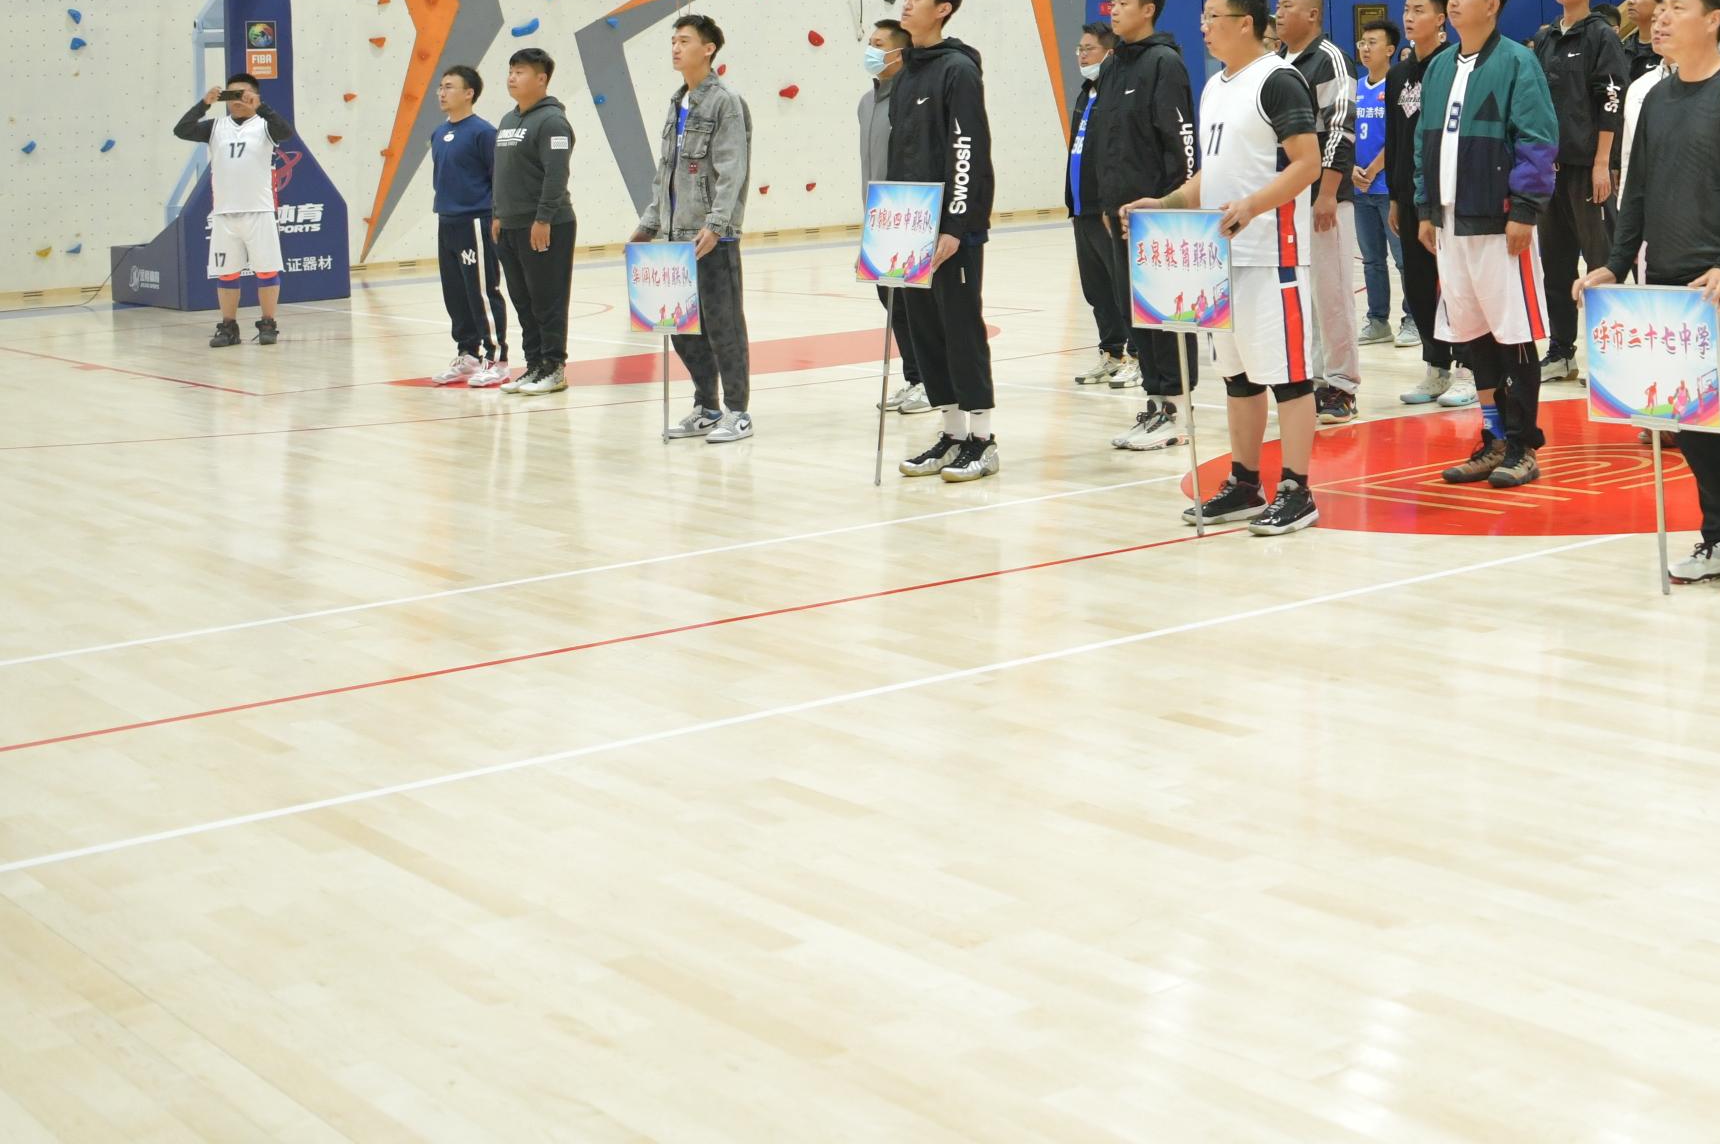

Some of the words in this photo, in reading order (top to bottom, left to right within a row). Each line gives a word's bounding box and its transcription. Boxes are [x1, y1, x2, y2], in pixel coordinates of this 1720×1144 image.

[252, 54, 272, 64] FIBA
[1207, 122, 1224, 156] 11
[1360, 123, 1368, 140] 3
[229, 142, 246, 159] 17
[949, 136, 972, 214] Swoosh
[215, 252, 226, 267] 17
[1593, 320, 1710, 359] 呼市二十七中学
